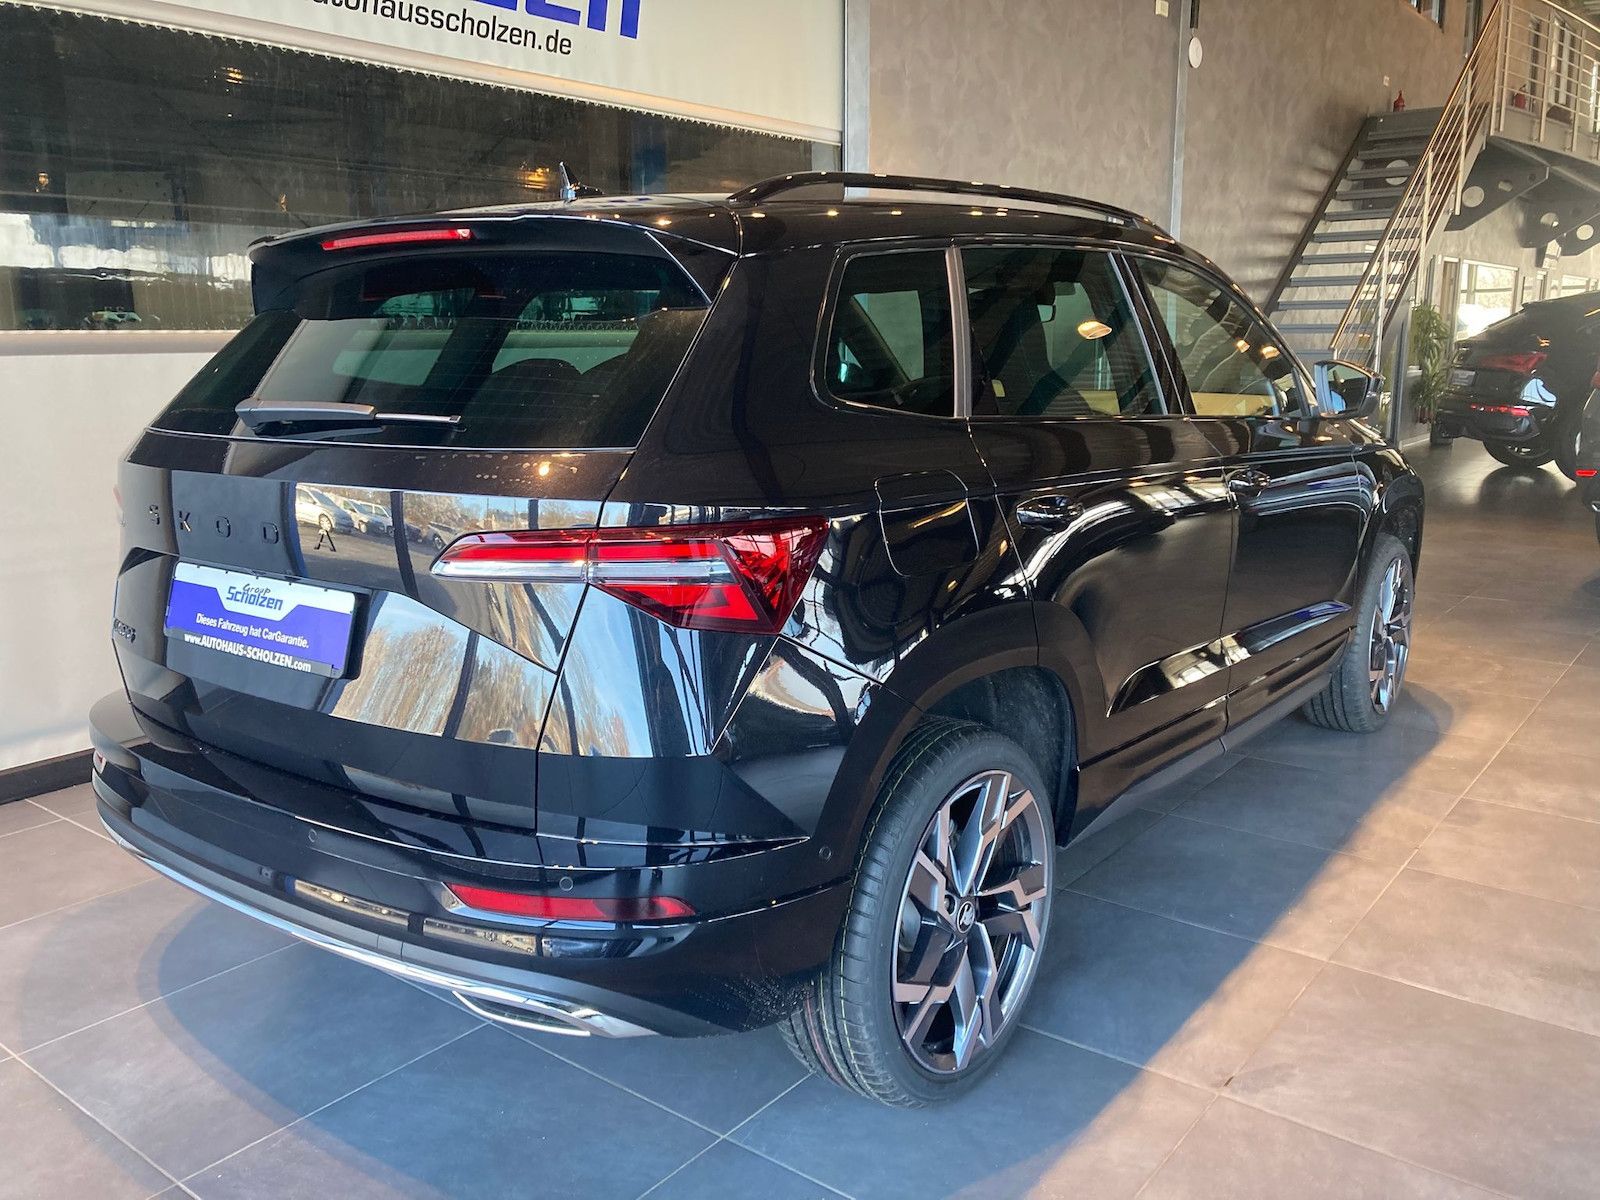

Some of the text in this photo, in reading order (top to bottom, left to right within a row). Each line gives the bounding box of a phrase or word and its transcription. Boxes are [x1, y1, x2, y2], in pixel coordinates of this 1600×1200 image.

[226, 586, 284, 611] Scholzen
[242, 583, 271, 596] Group
[195, 612, 310, 649] Dieses Fahrzeug hat CarGarantie.
[184, 633, 312, 673] www.AUTOHAUS-SCHOLZEN.com
